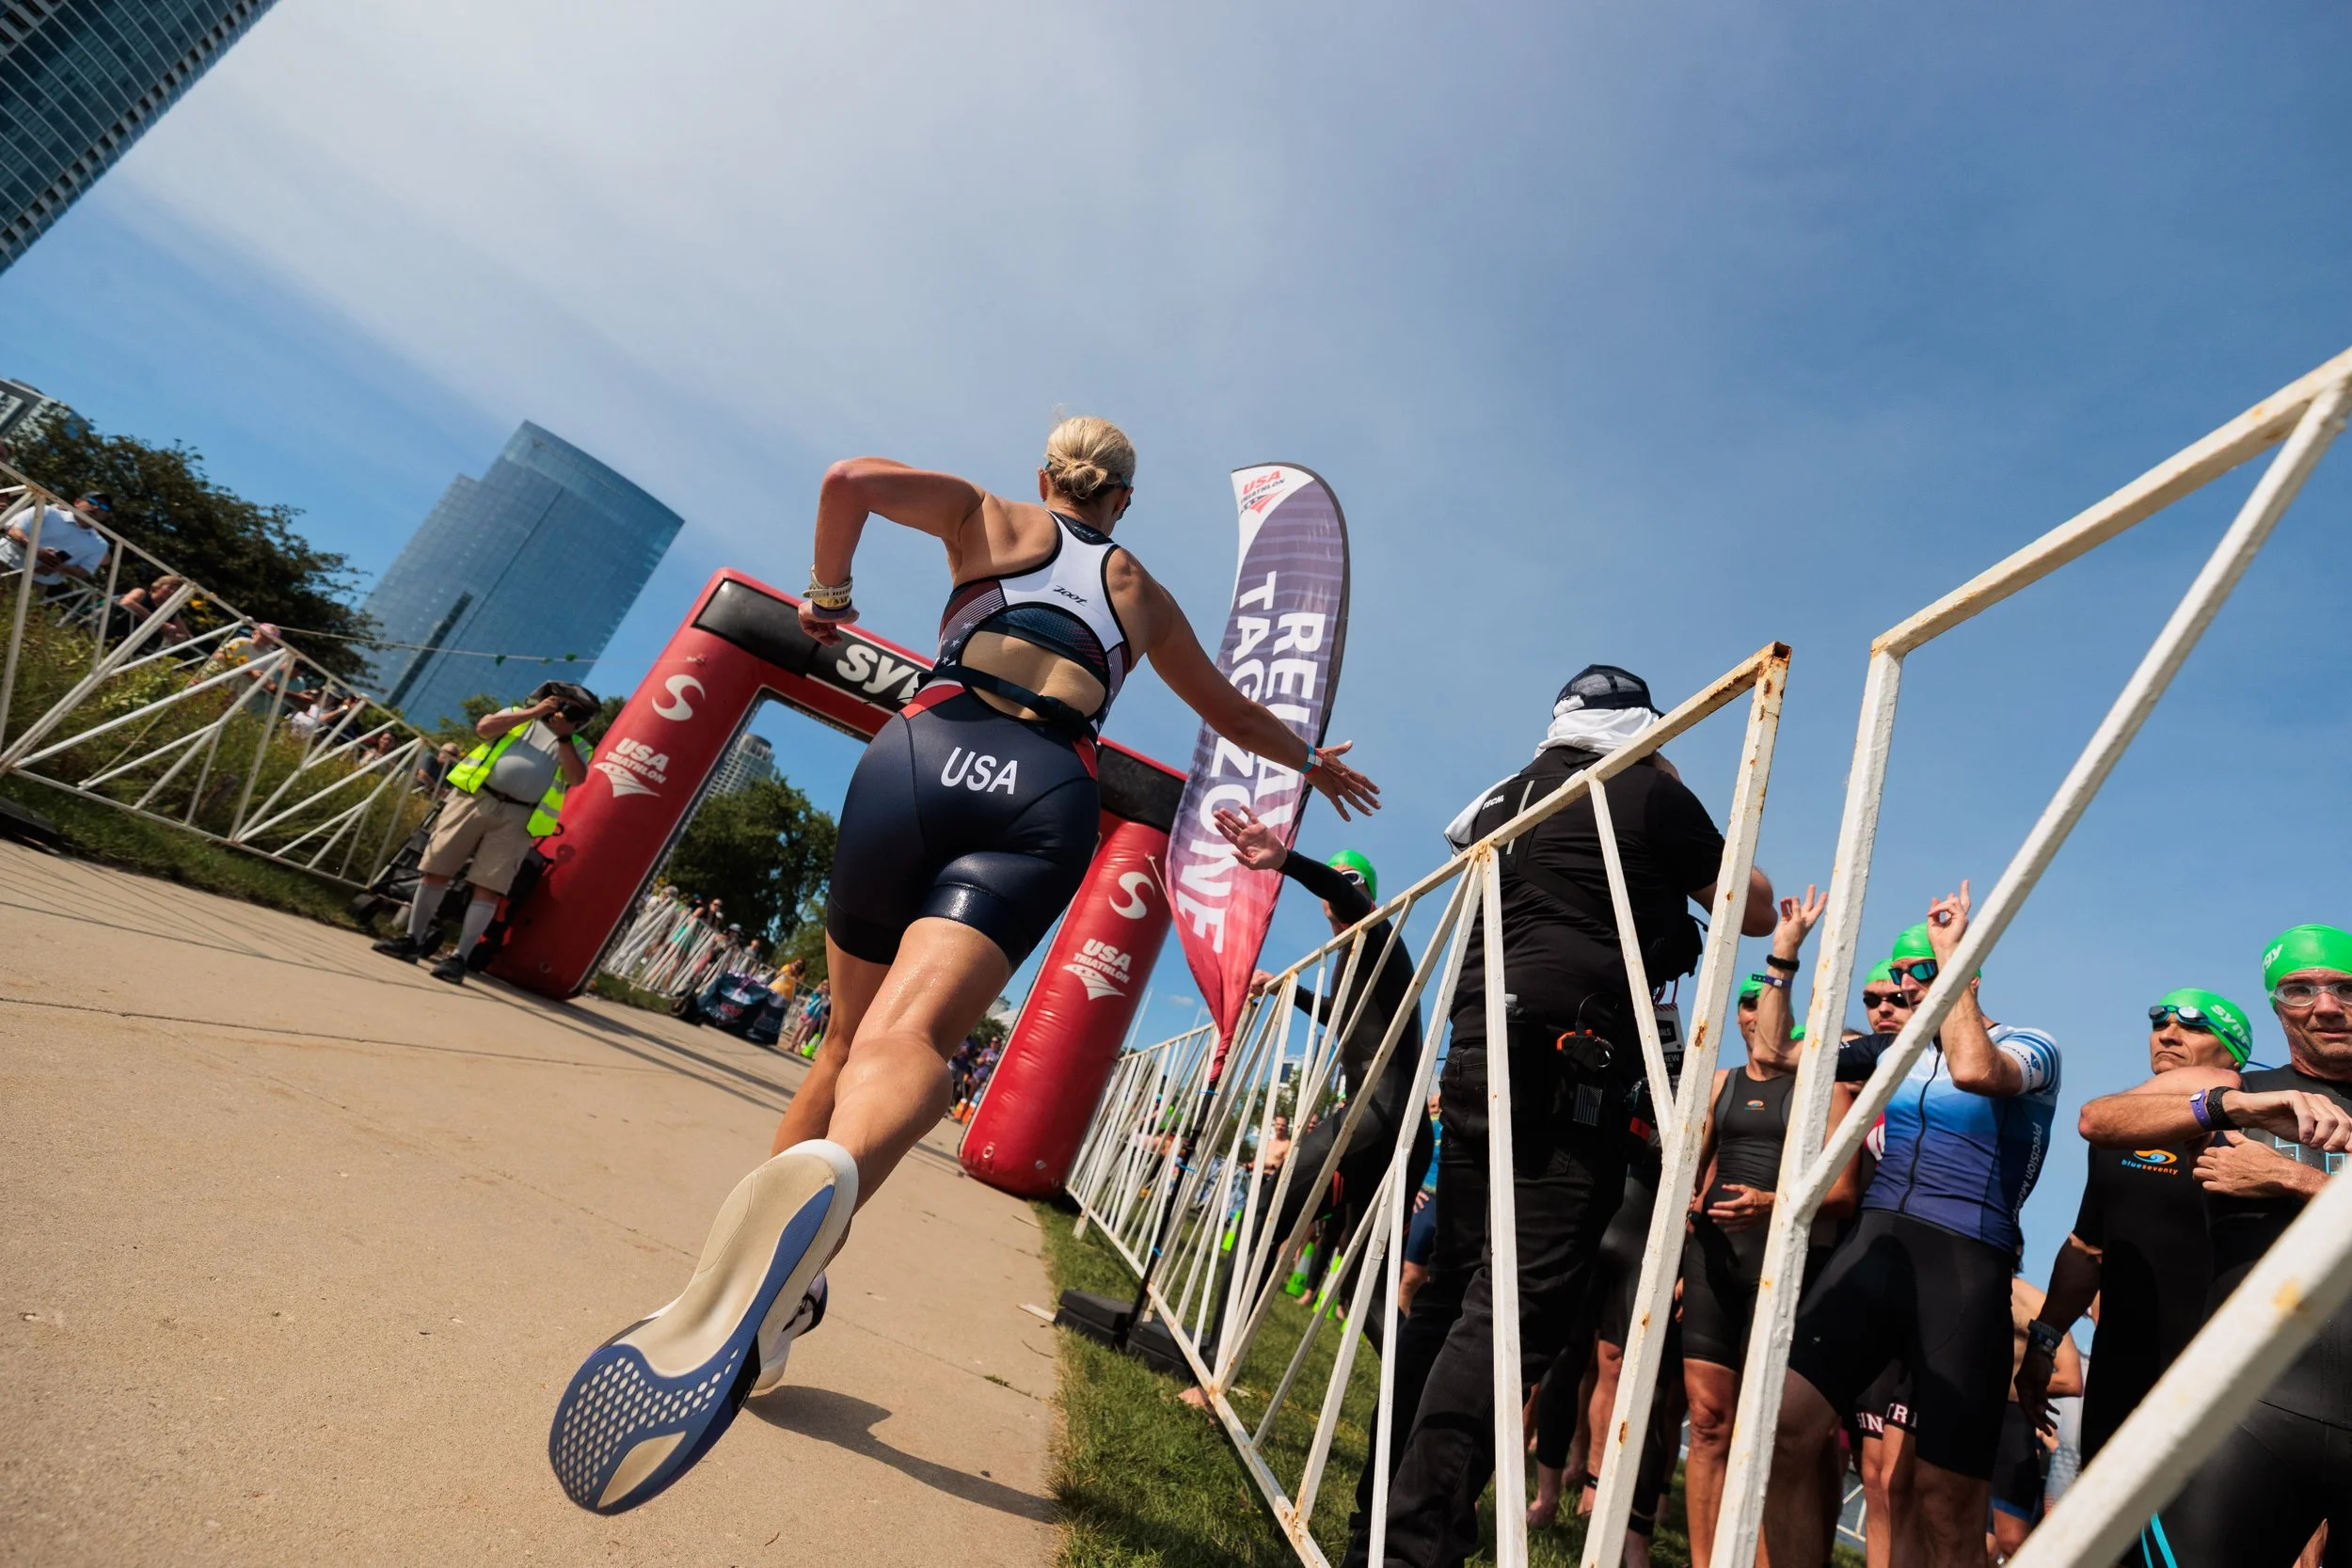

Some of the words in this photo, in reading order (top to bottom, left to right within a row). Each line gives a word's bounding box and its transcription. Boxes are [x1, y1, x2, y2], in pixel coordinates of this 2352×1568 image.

[1243, 469, 1280, 495] USA
[1229, 571, 1277, 703] TAG
[605, 752, 667, 784] TRIATHLON
[615, 737, 669, 773] USA
[941, 747, 1018, 795] USA
[1176, 736, 1254, 954] ZONE
[1073, 952, 1130, 984] TRIATHLON
[1082, 938, 1132, 972] USA
[2025, 1121, 2042, 1180] Precision
[2122, 1159, 2179, 1175] blueseventy
